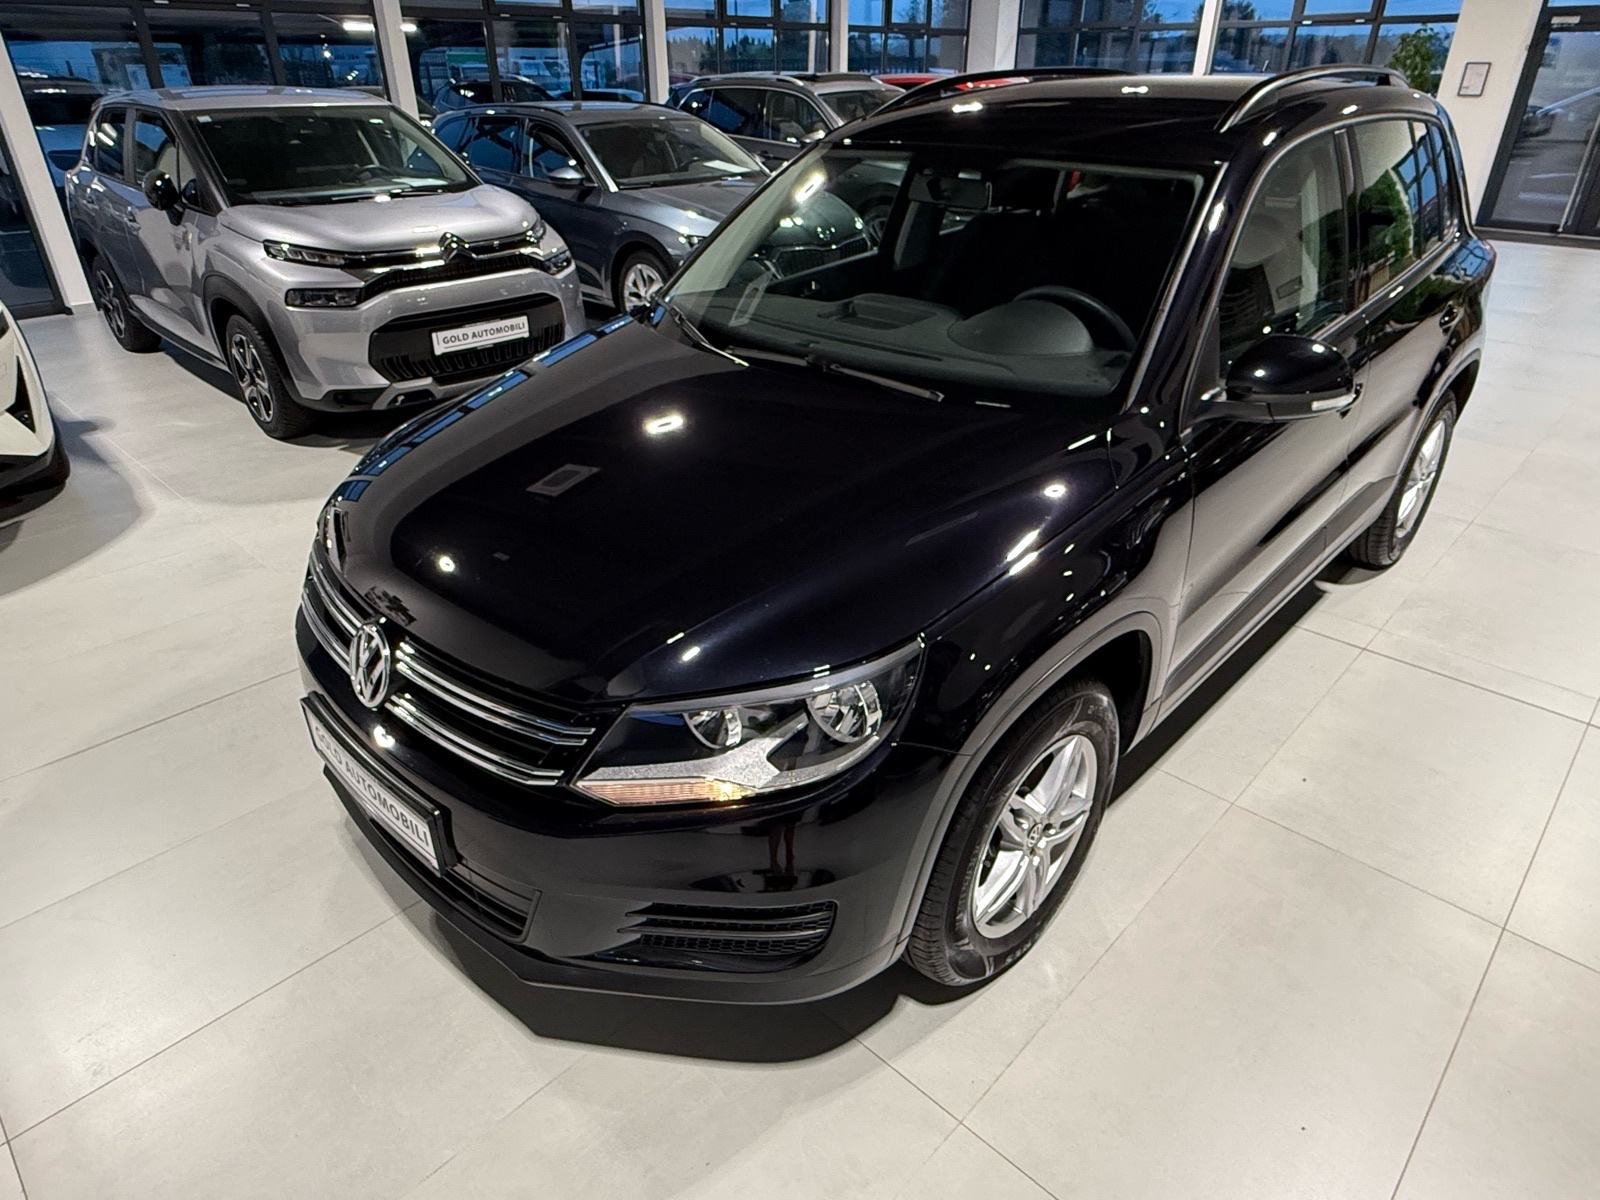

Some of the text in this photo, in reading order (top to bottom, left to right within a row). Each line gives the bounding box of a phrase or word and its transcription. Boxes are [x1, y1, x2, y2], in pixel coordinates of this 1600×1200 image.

[442, 322, 526, 345] GOLD AUTOMOBILI
[345, 761, 430, 847] AUTOMOBILI
